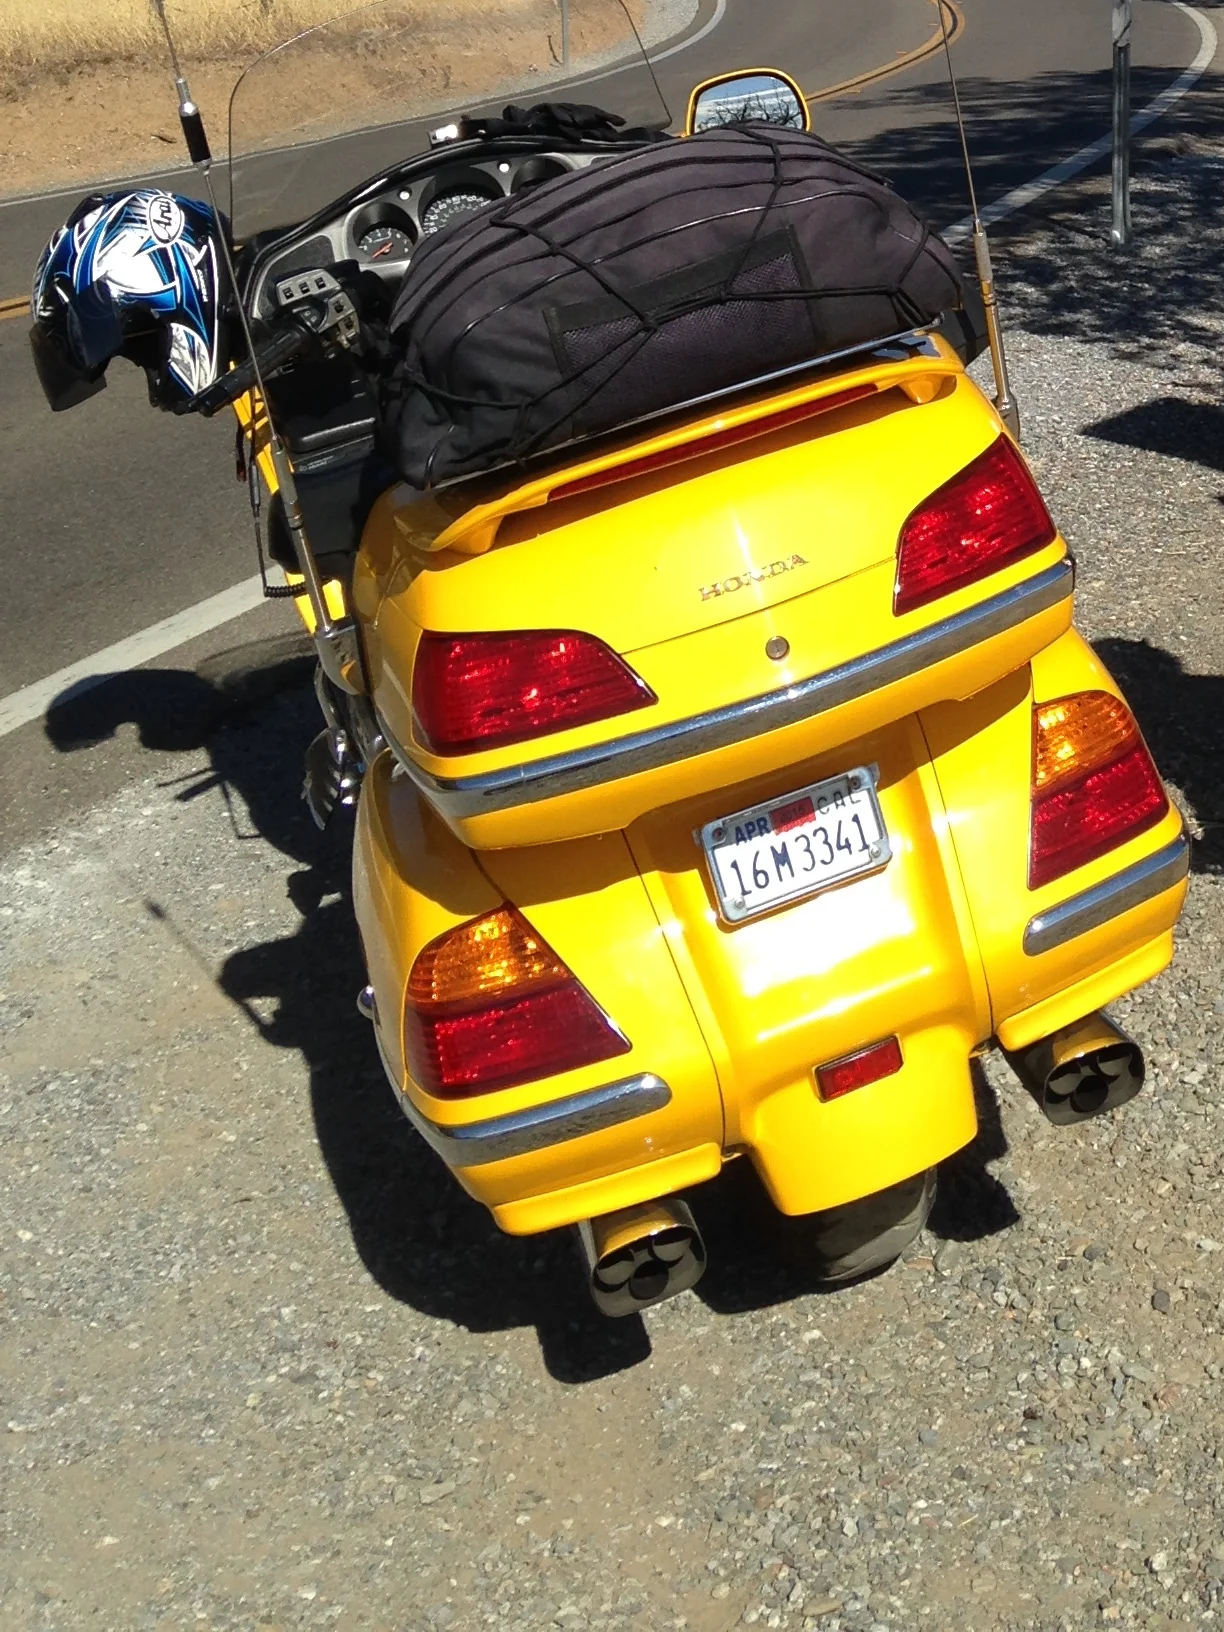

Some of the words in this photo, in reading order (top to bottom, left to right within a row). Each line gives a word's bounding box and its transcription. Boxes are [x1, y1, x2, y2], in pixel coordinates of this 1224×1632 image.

[152, 199, 173, 241] Arai
[698, 554, 810, 602] HONDA
[734, 816, 771, 846] APR
[816, 784, 862, 815] CAL
[730, 813, 870, 897] 16M3341
